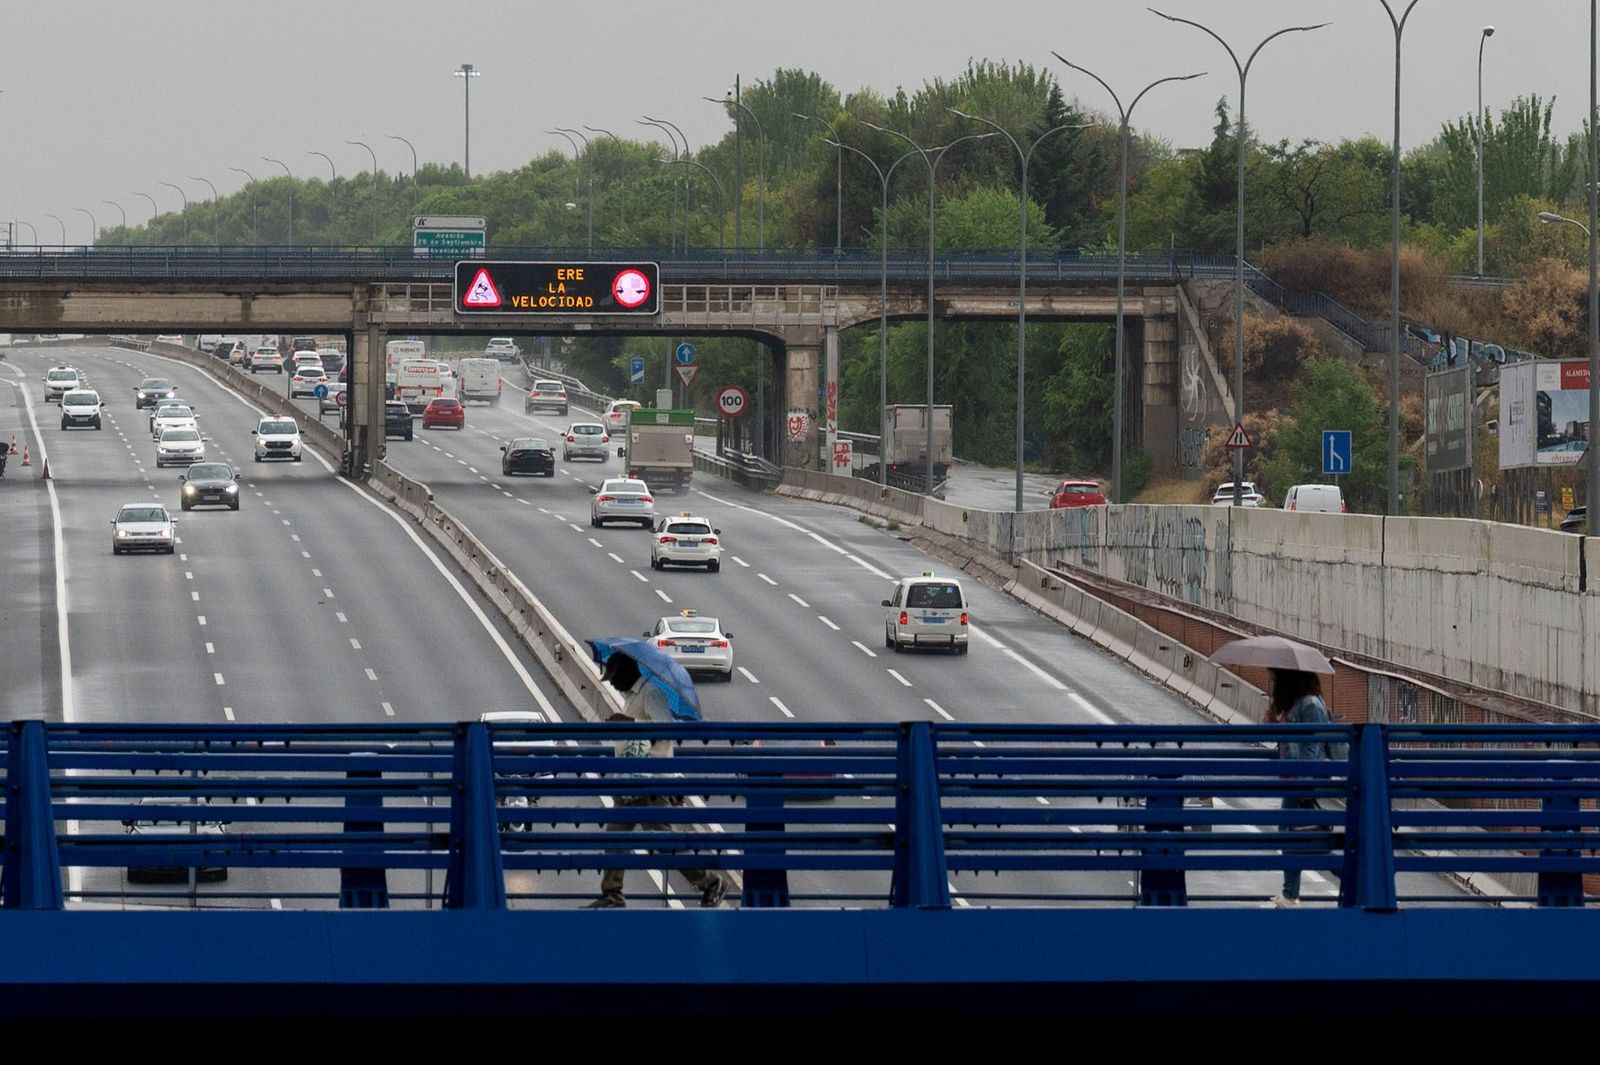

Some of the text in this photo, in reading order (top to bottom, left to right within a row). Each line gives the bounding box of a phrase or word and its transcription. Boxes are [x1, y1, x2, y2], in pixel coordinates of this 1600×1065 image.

[557, 268, 585, 281] ERE
[548, 282, 565, 294] LA
[512, 295, 593, 308] VELOCIDAD
[721, 395, 742, 407] 100
